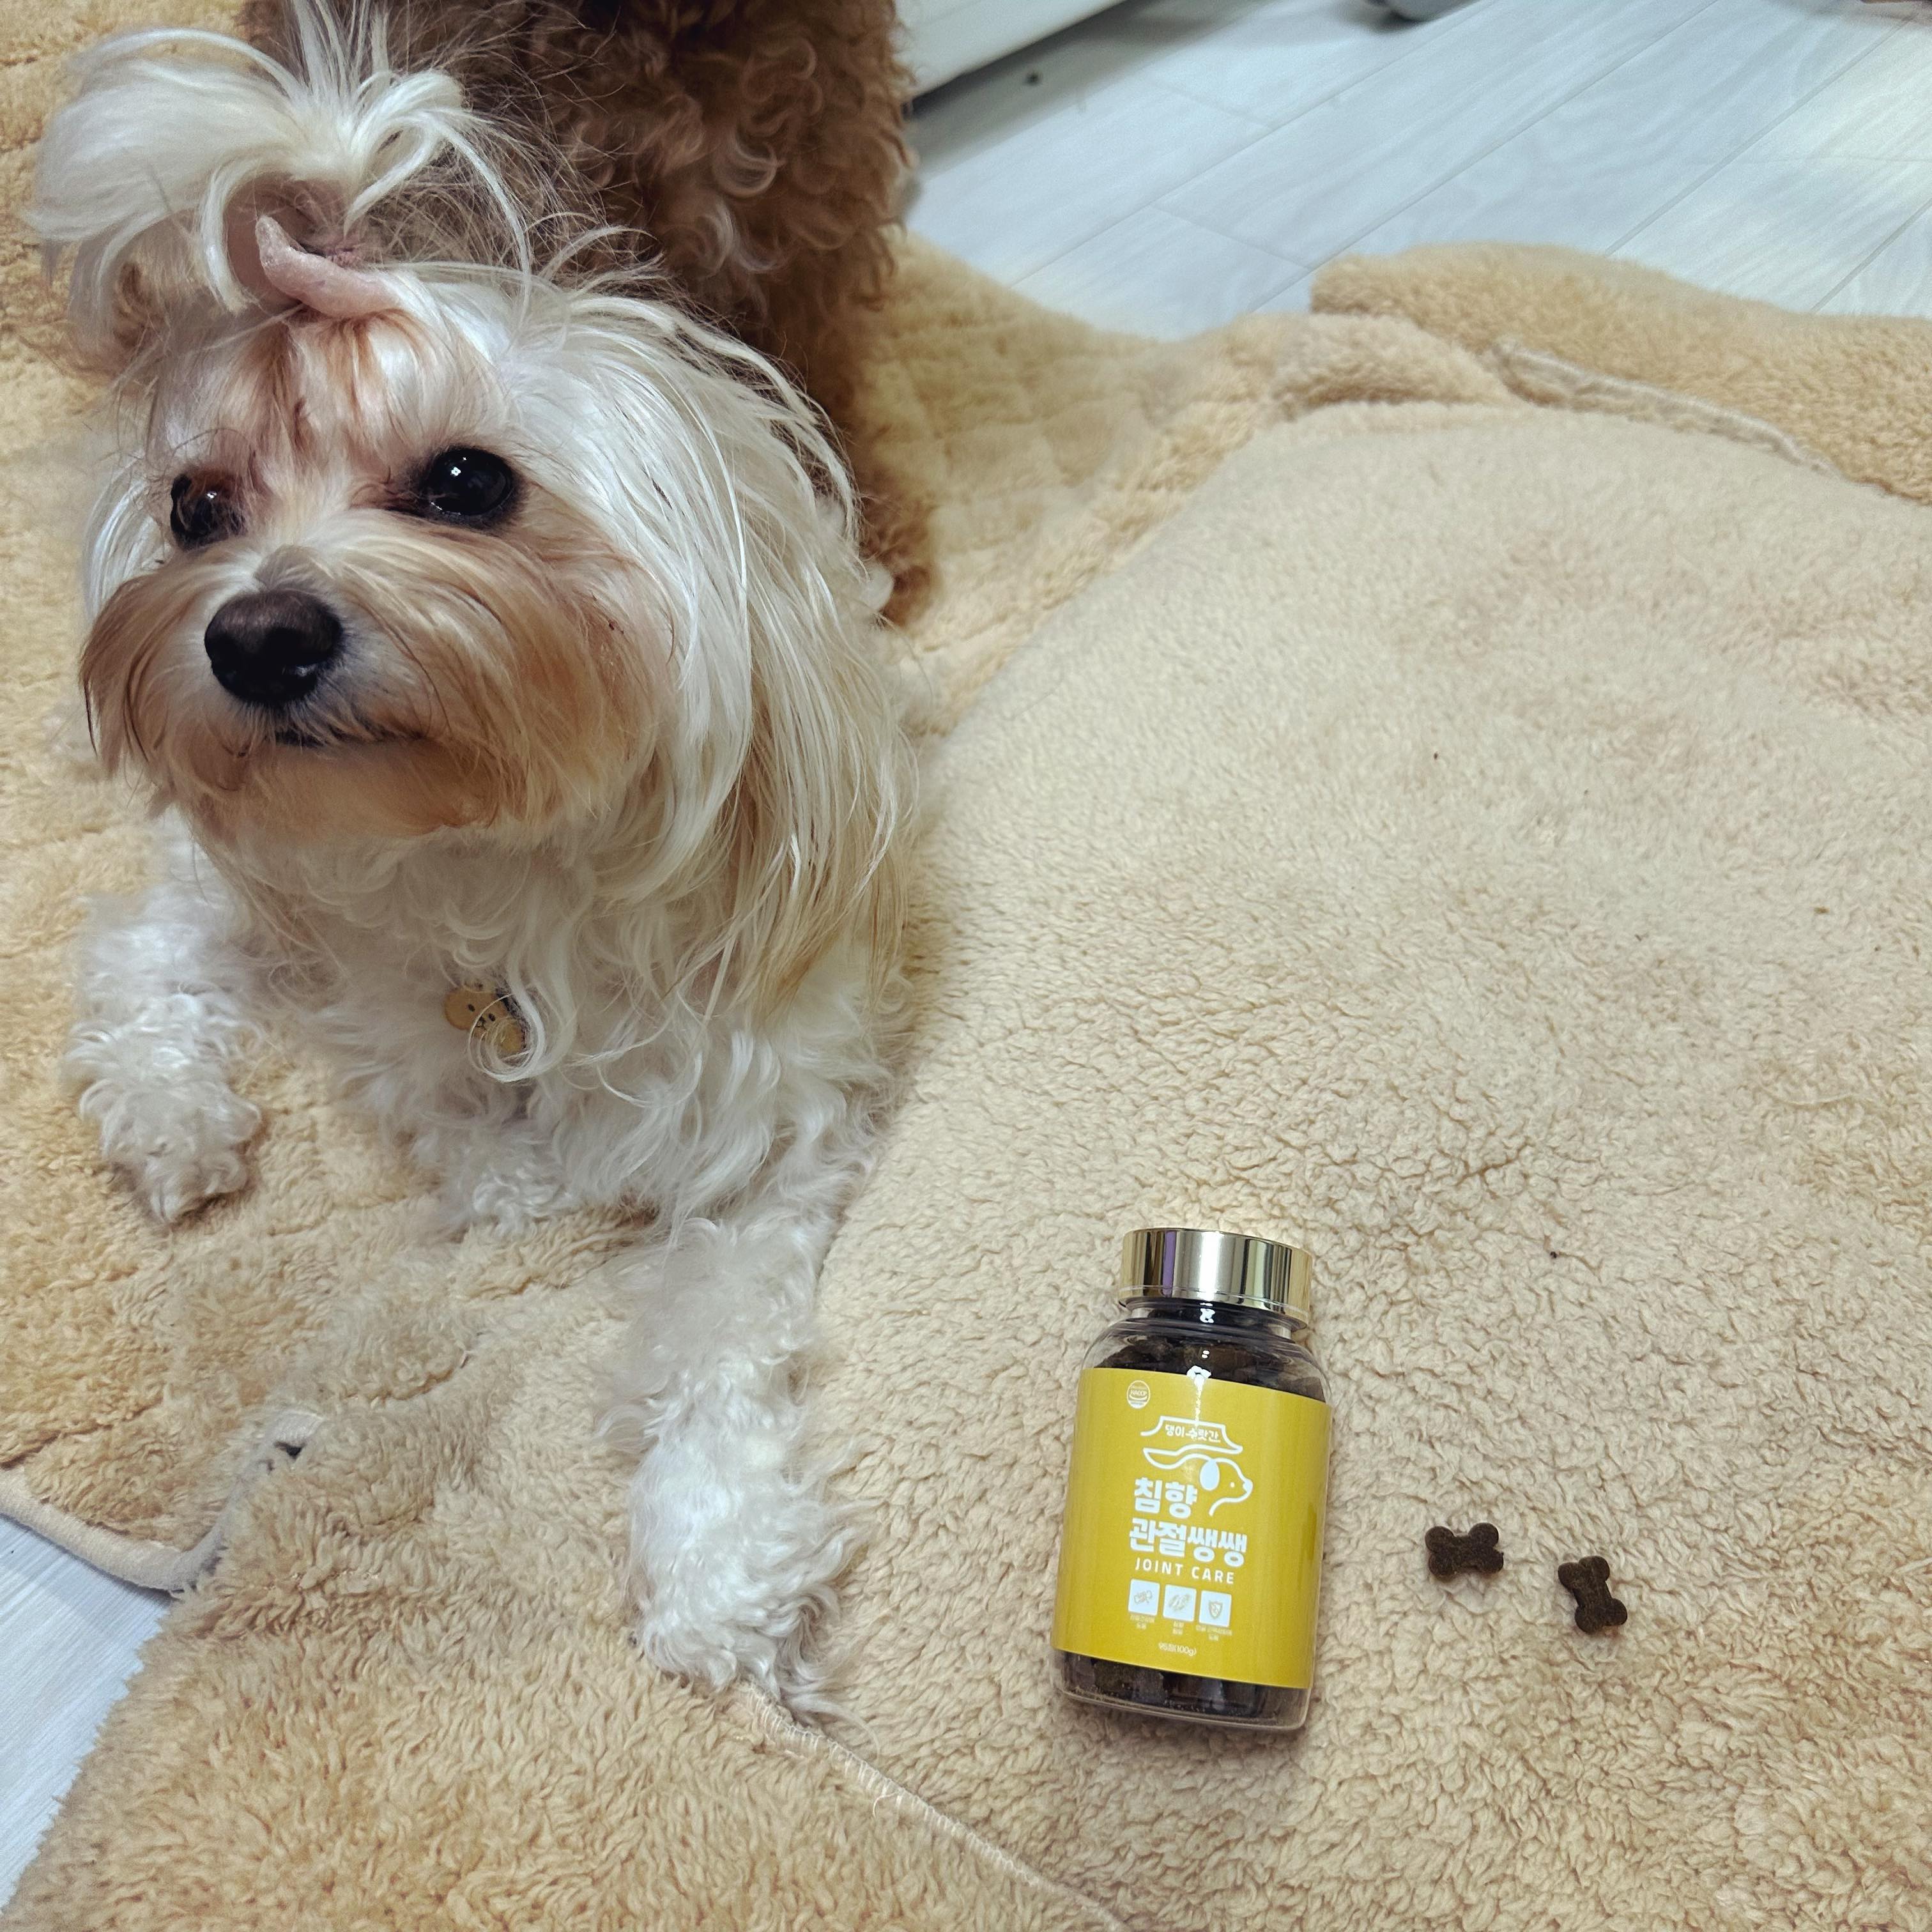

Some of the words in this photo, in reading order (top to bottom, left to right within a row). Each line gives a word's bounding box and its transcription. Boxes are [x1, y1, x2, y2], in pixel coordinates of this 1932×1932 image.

[1133, 1476, 1199, 1519] 침향
[1129, 1517, 1248, 1568] 관절쌩쌩
[1135, 1556, 1183, 1577] JOINT
[1191, 1566, 1235, 1584] CARE
